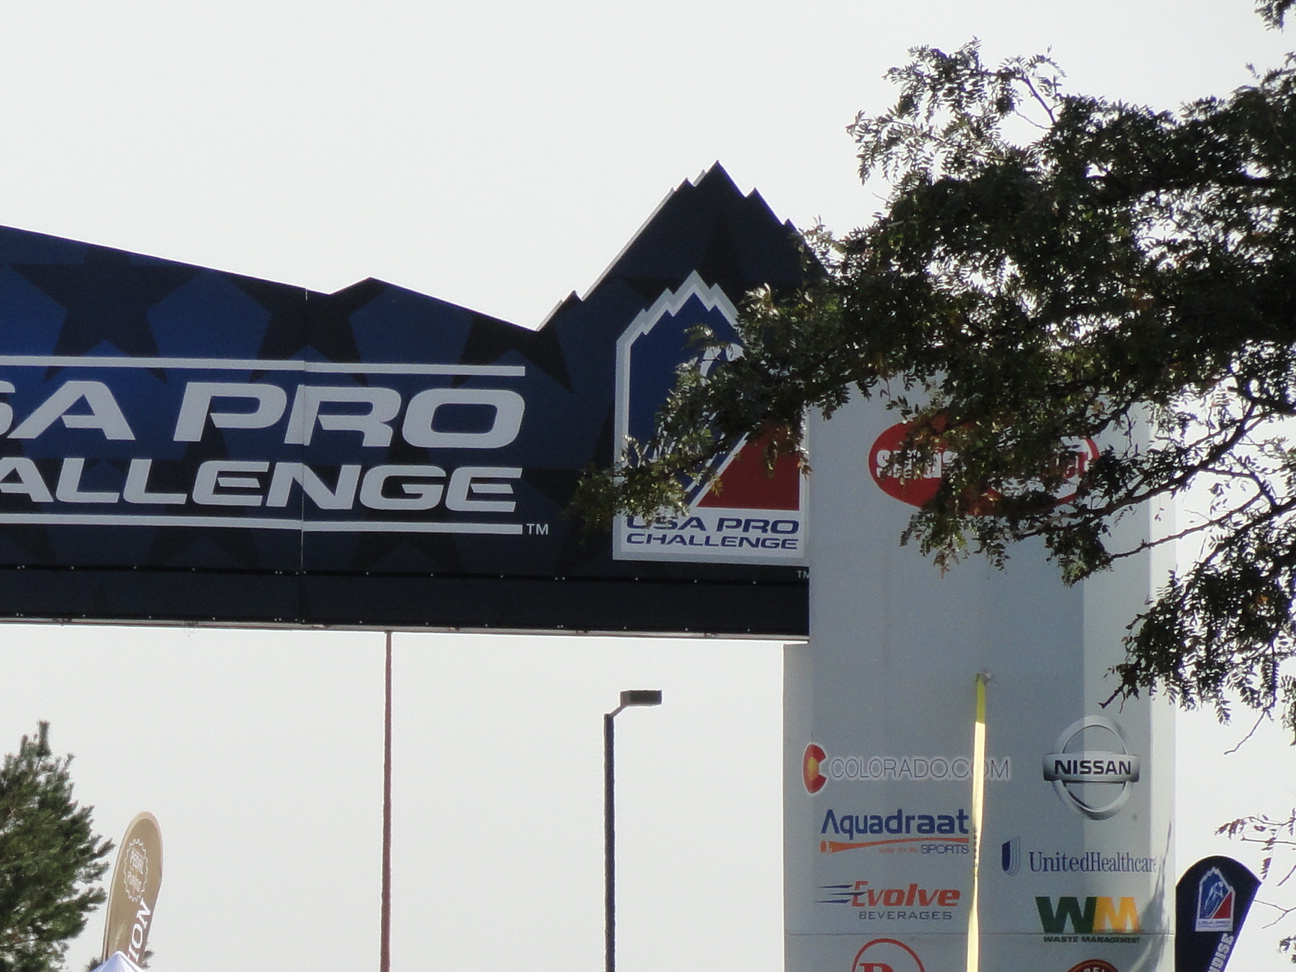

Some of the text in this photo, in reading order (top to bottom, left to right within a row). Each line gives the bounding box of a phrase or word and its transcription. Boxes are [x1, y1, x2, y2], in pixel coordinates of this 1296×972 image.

[173, 381, 526, 449] PRO
[526, 523, 549, 536] TM
[626, 516, 800, 534] USA PRO
[626, 533, 799, 550] CHALLENGE
[1054, 759, 1132, 776] NISSAN
[820, 808, 969, 840] Aquadraat
[921, 844, 969, 854] SPORTS
[851, 881, 961, 907] Evolve
[859, 911, 952, 920] BEVERAGES
[1035, 896, 1142, 934] WM
[1043, 935, 1140, 944] WASTE MANAGEMENT
